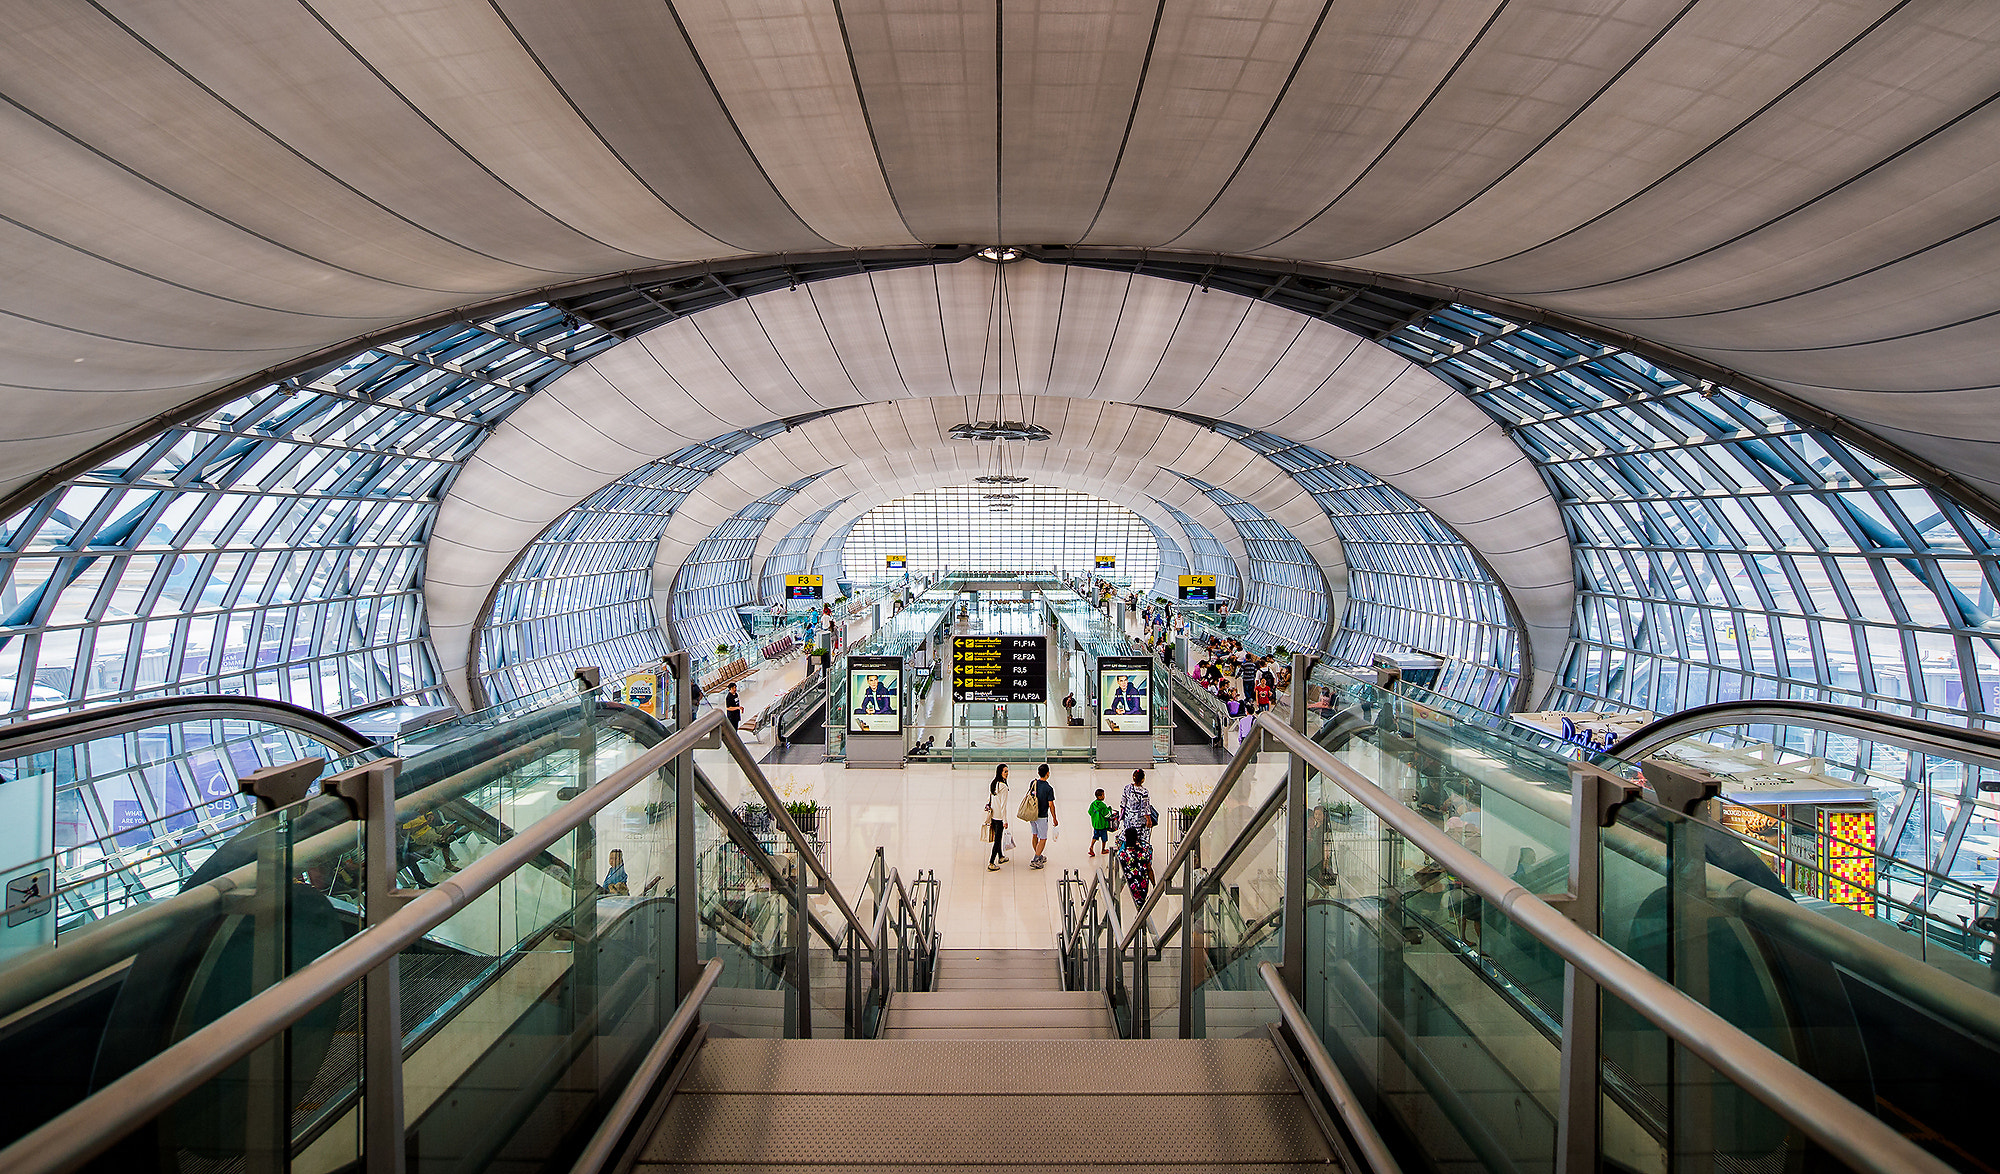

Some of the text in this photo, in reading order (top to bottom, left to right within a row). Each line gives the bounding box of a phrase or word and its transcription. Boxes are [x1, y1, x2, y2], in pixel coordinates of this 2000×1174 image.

[798, 576, 810, 584] F3
[1191, 576, 1203, 584] F4
[1013, 640, 1036, 648] F1,F1A
[1013, 653, 1036, 661] F2,F2A
[207, 800, 231, 810] SCB
